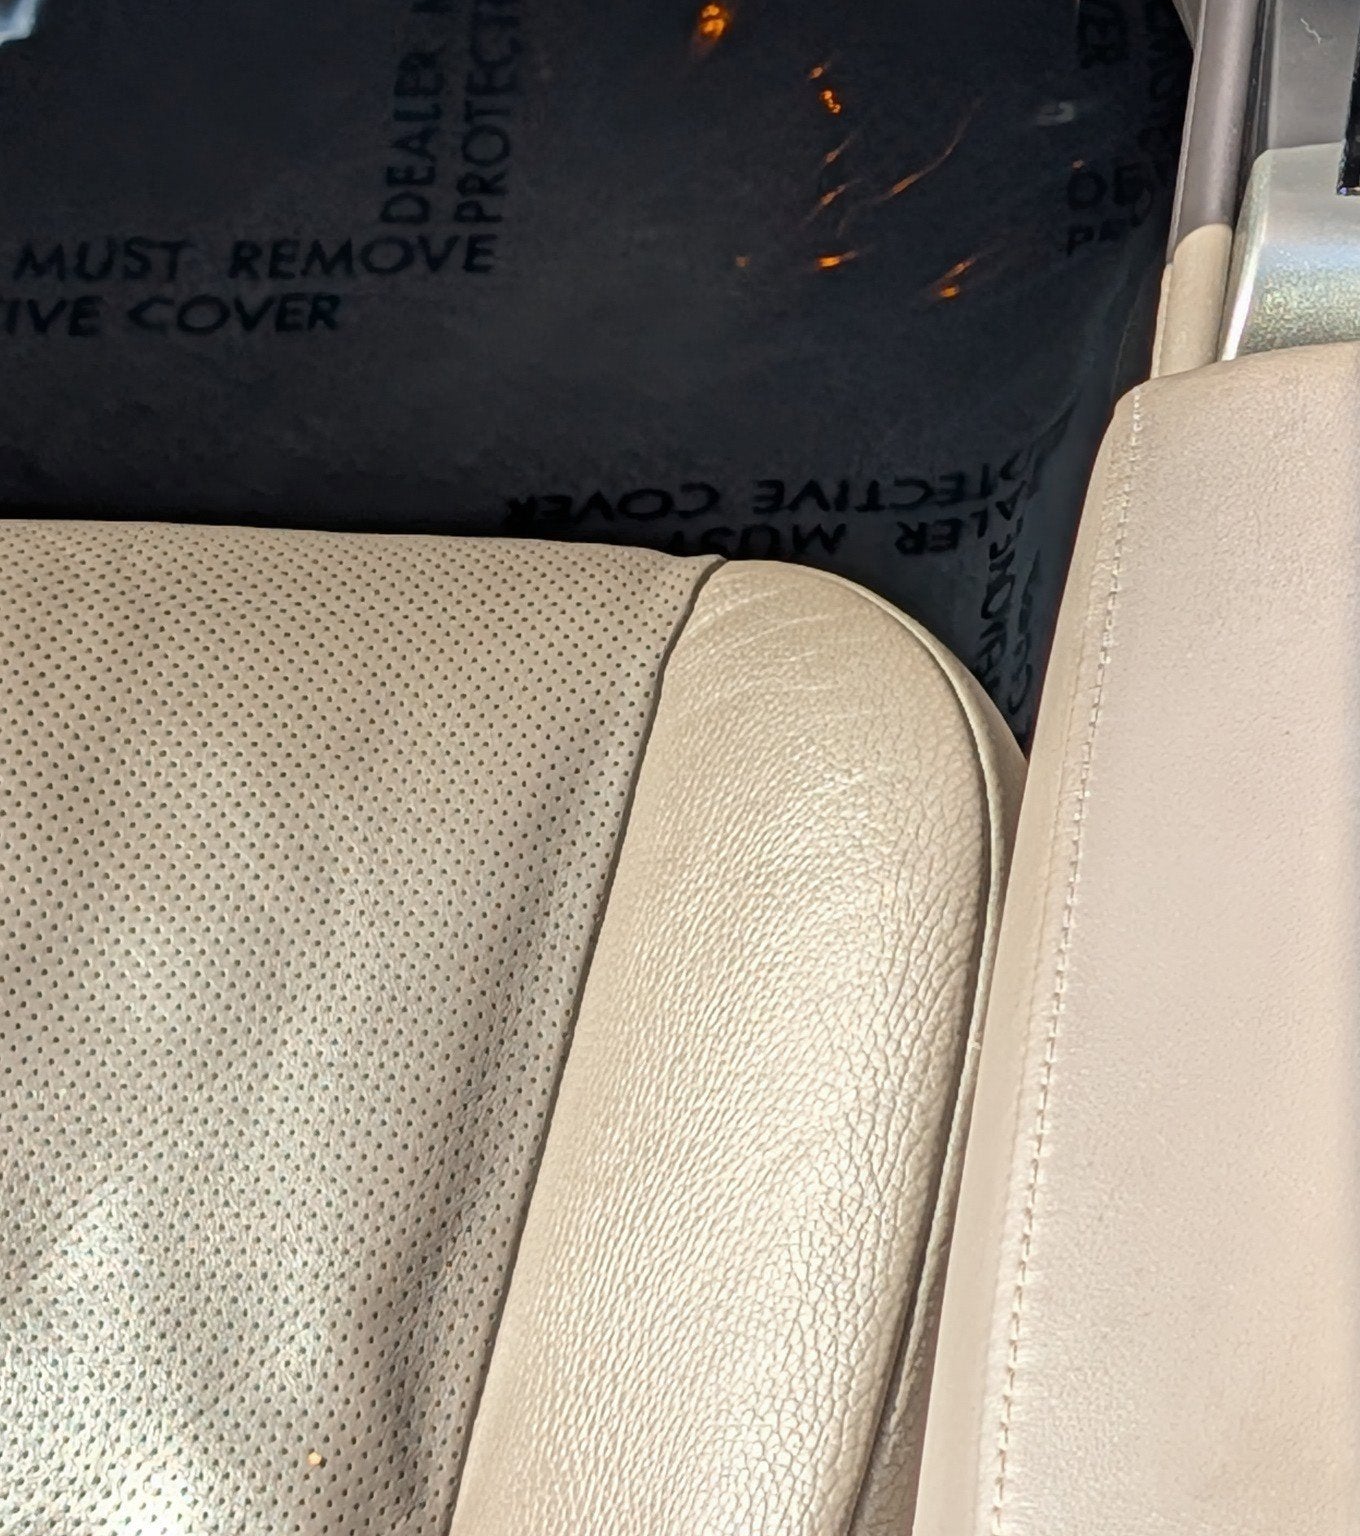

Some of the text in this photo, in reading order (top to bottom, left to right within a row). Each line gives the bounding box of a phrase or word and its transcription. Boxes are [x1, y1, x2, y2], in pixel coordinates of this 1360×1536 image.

[380, 50, 445, 225] DEALER
[12, 234, 500, 283] MUST REMOVE
[127, 293, 342, 336] COVER
[502, 480, 721, 532] COVER
